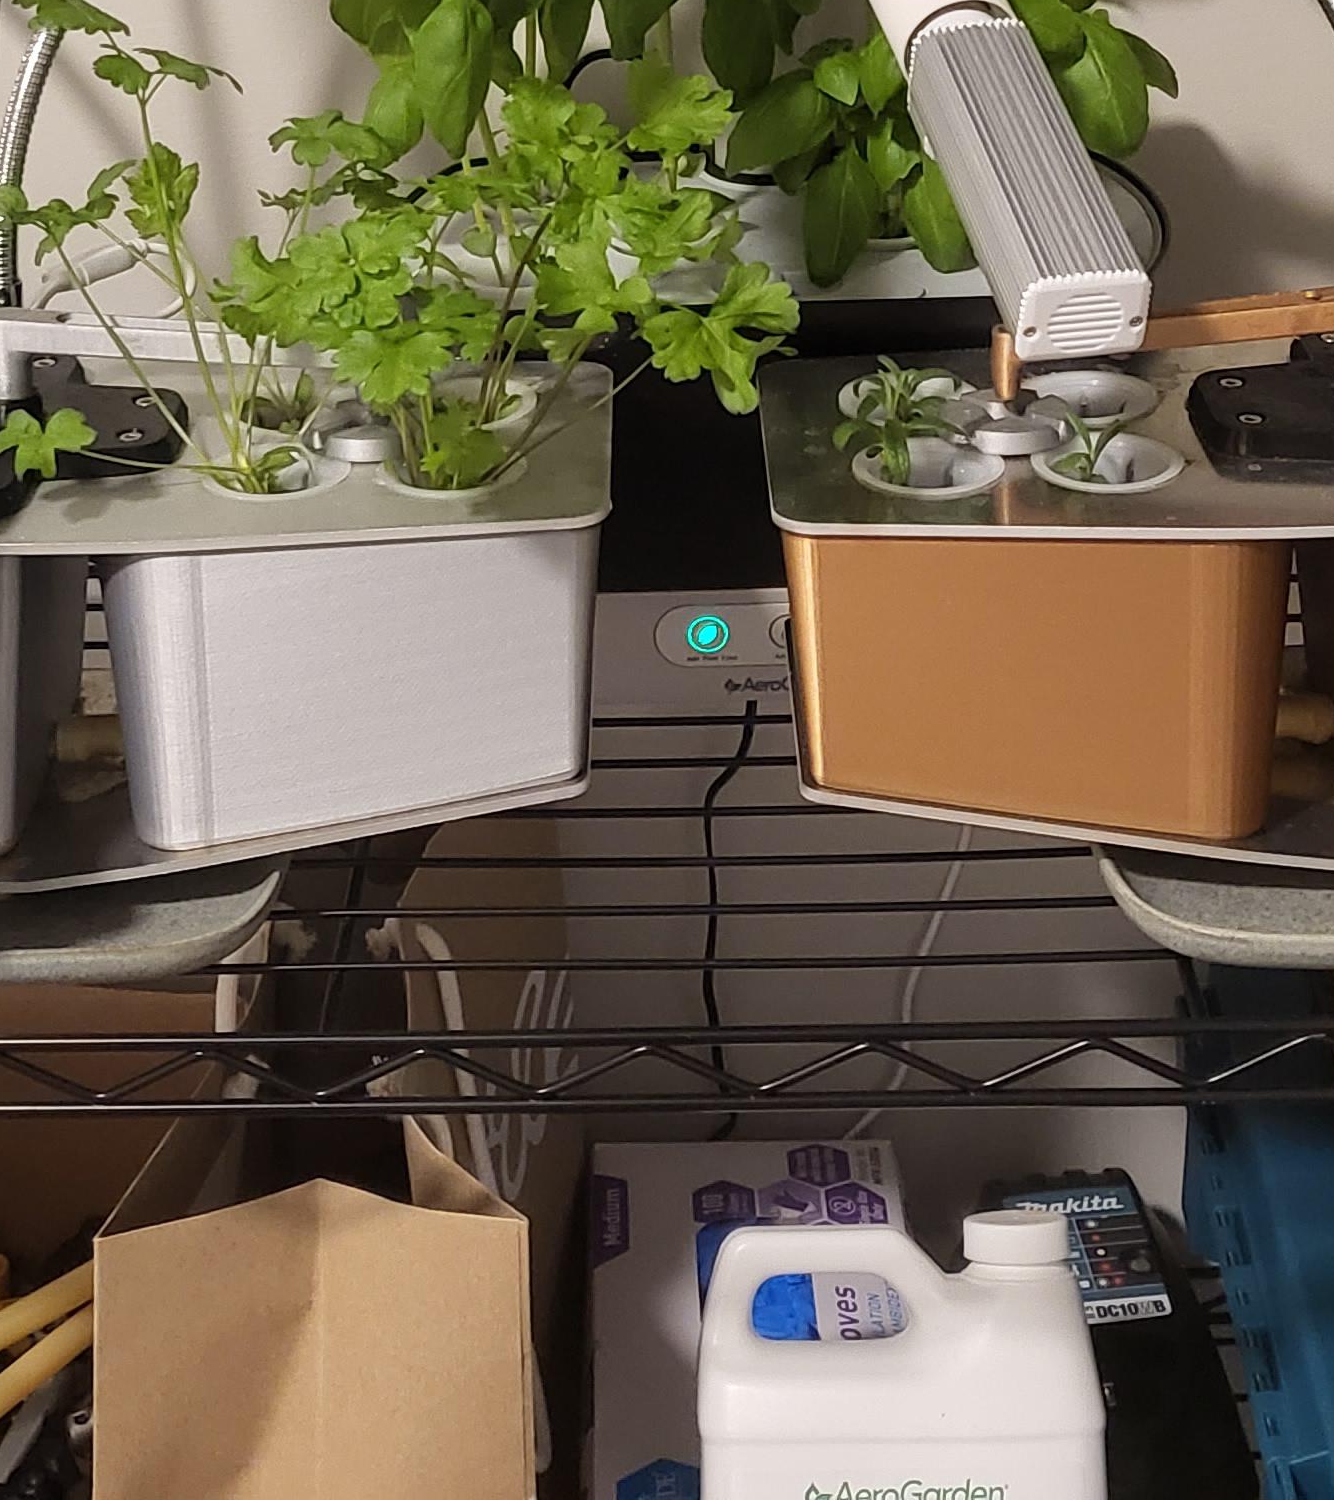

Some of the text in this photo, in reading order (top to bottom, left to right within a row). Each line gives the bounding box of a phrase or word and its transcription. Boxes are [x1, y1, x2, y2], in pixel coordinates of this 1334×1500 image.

[603, 1188, 620, 1245] Medium
[1016, 1195, 1125, 1214] makita
[835, 1286, 861, 1340] oves
